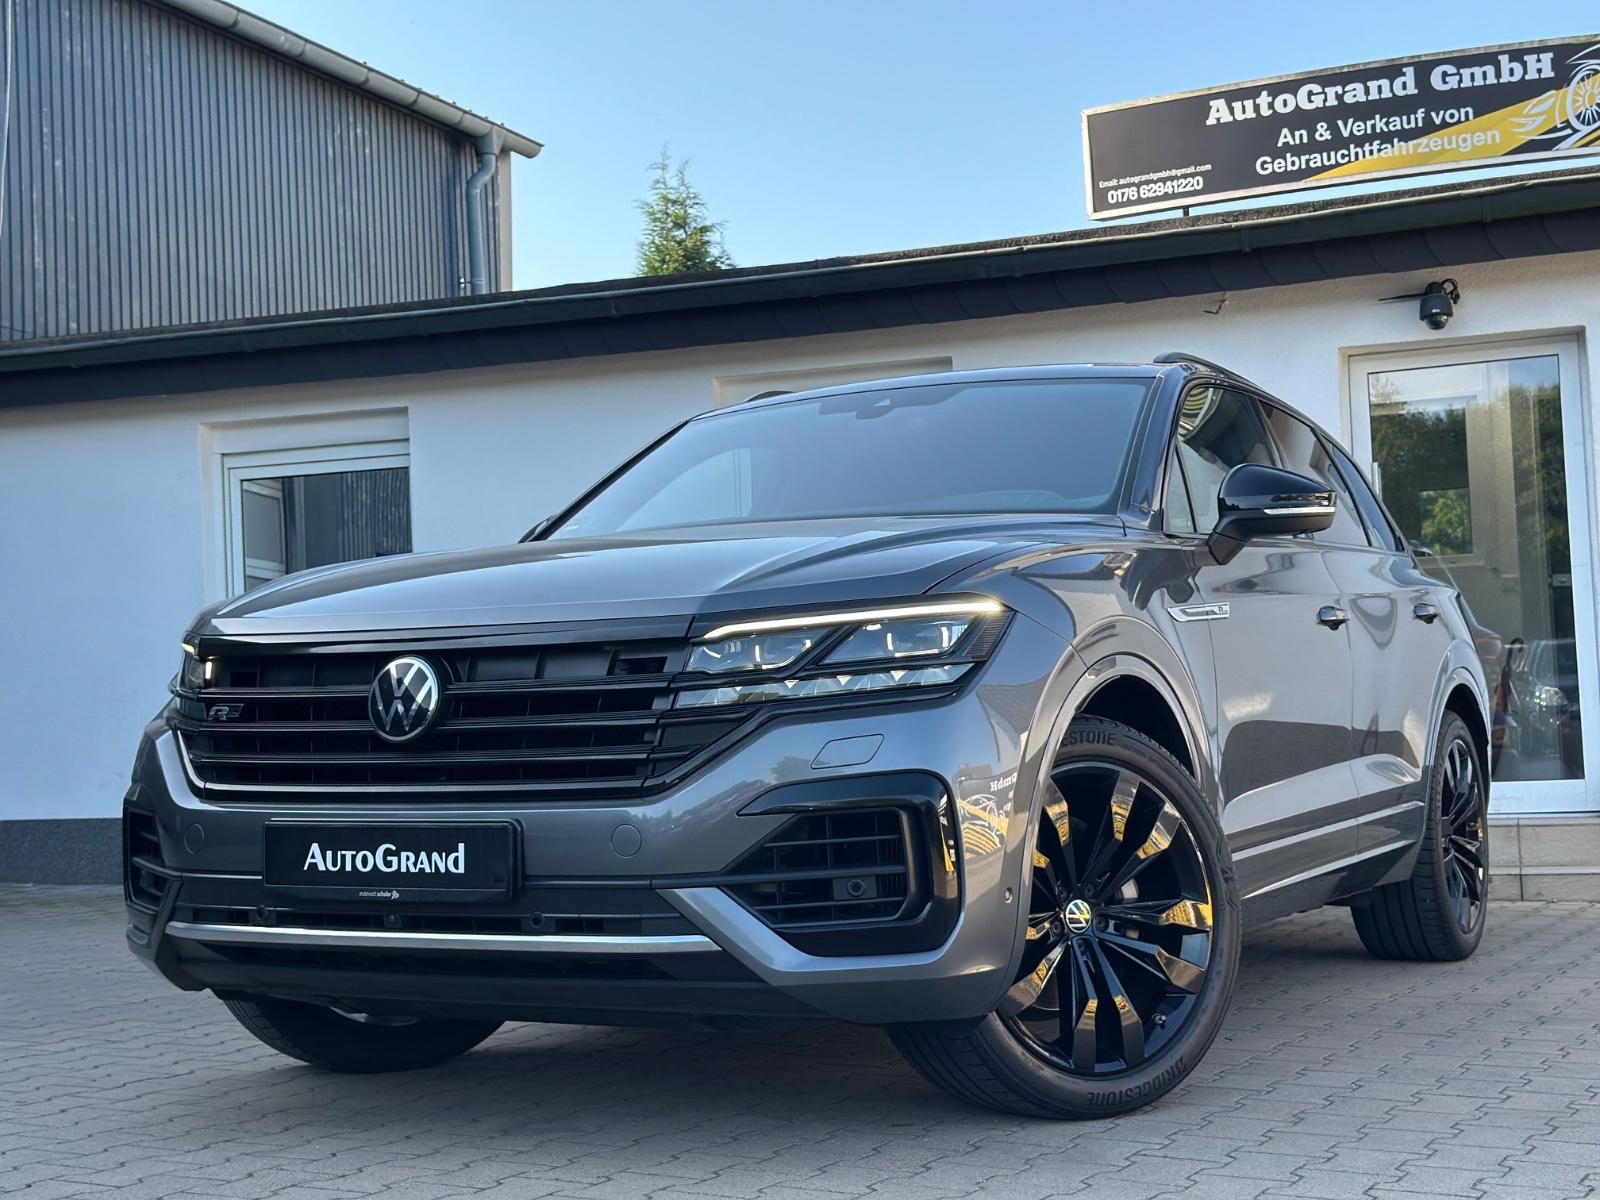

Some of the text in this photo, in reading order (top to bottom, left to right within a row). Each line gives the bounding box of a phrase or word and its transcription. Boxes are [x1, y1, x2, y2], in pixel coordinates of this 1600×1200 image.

[1206, 52, 1555, 125] AutoGrand GmbH
[1277, 106, 1474, 147] An & Verkauf von
[1255, 128, 1500, 175] Gebrauchtfahrzeugen
[1107, 176, 1203, 204] 0176 62941220
